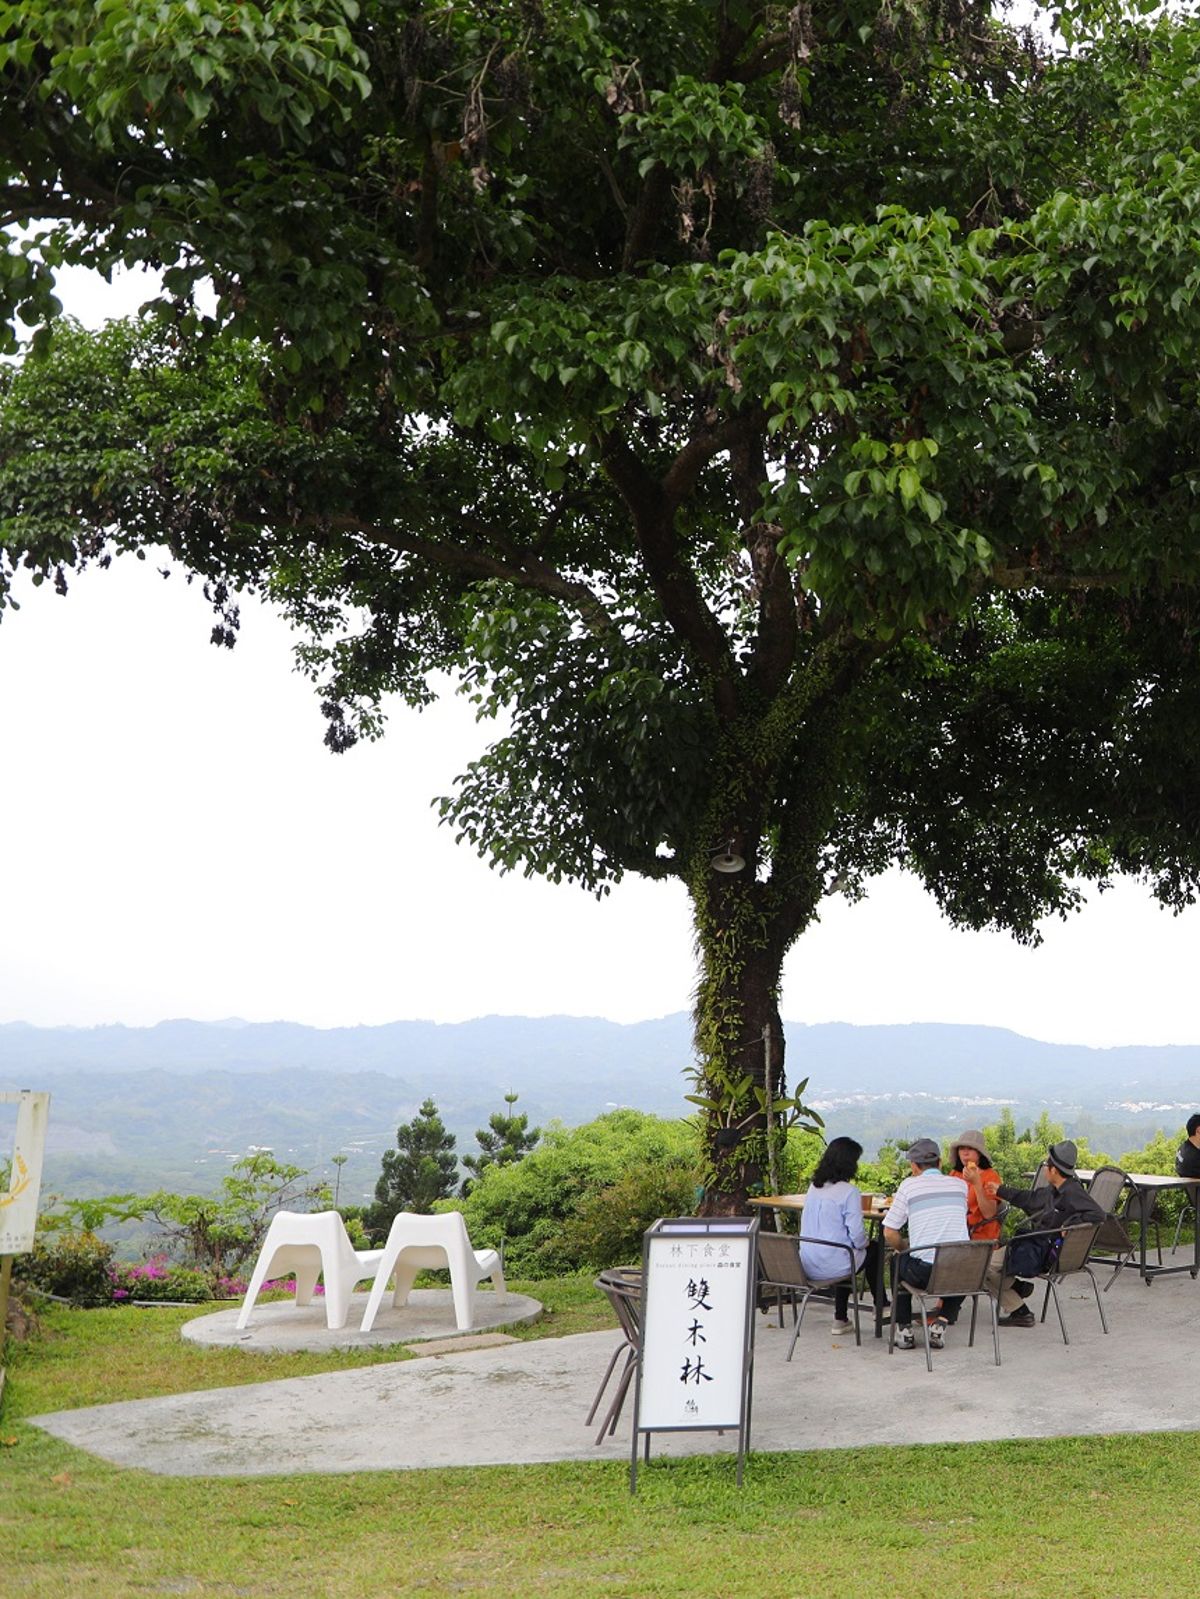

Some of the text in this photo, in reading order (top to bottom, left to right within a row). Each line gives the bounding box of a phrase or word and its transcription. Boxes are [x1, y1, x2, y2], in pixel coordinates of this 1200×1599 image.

[671, 1243, 731, 1257] 林下食堂
[679, 1278, 714, 1385] 雙木林
